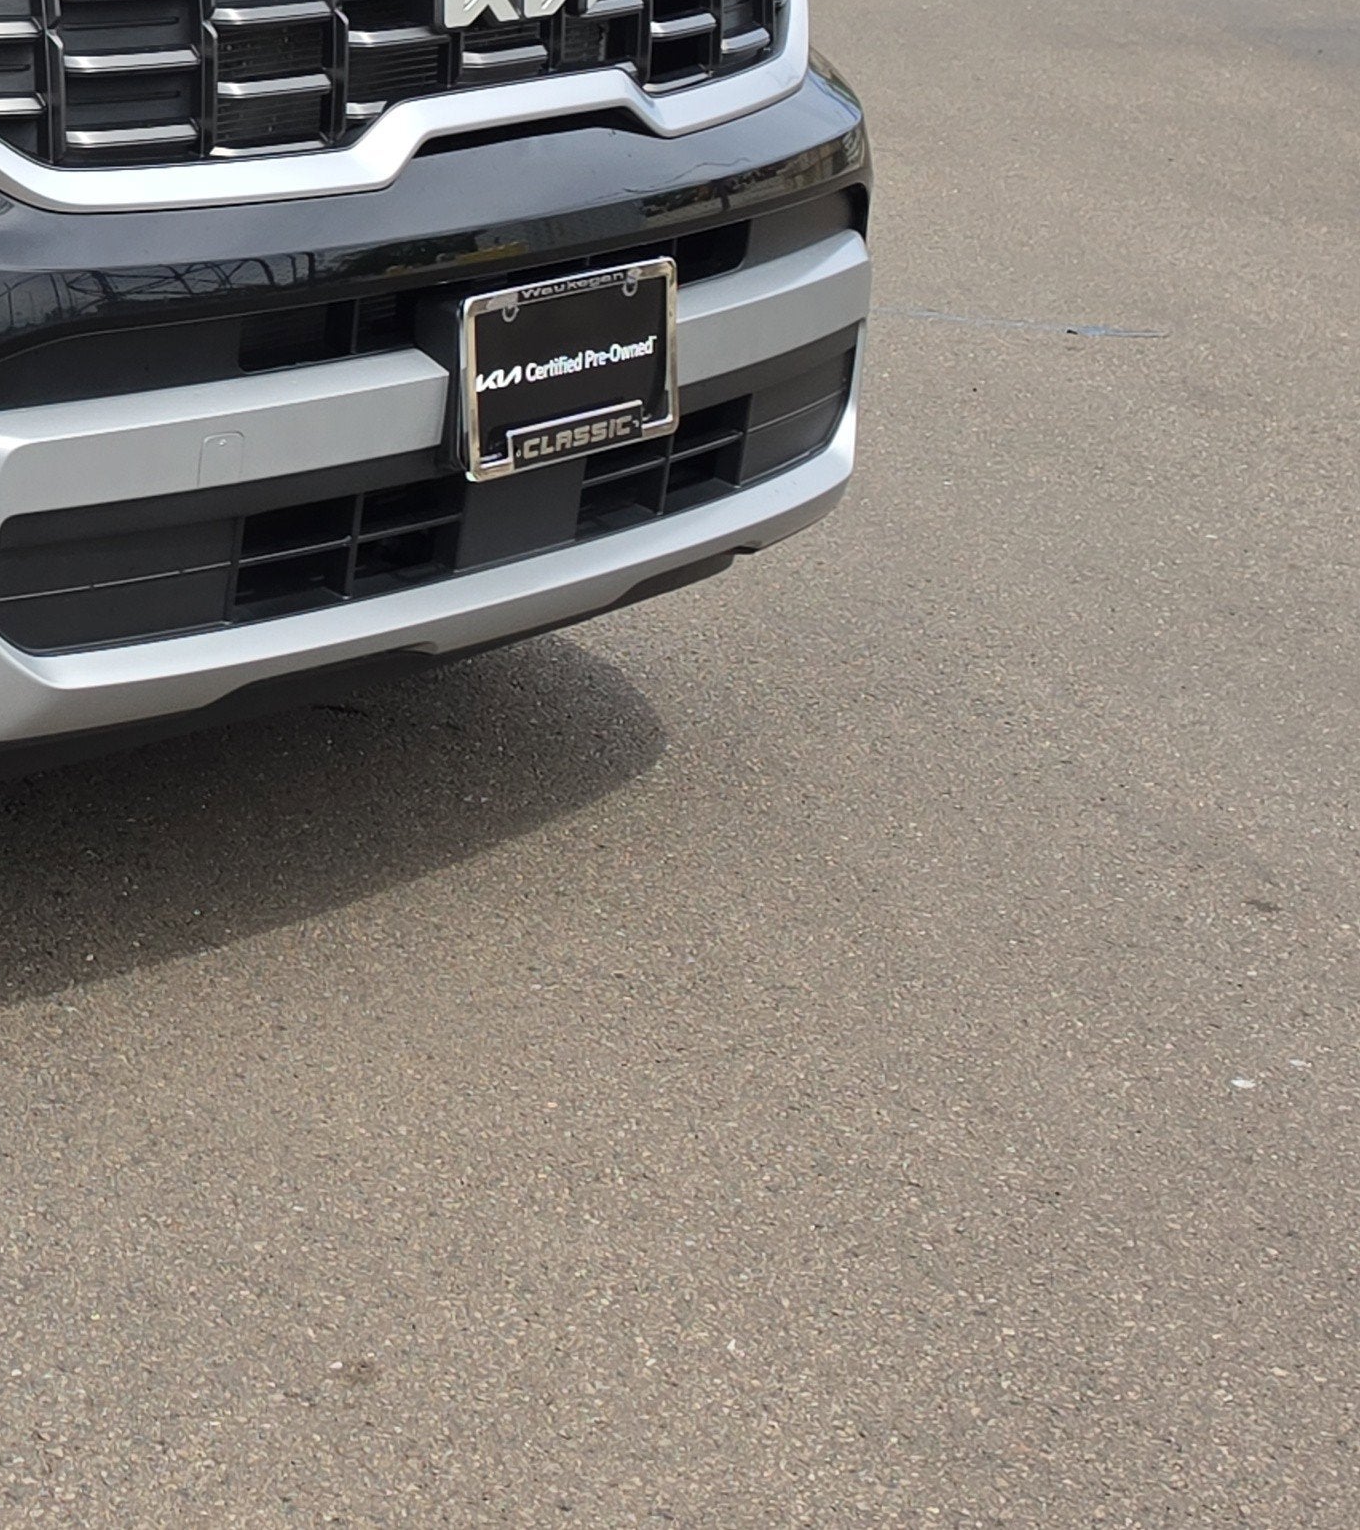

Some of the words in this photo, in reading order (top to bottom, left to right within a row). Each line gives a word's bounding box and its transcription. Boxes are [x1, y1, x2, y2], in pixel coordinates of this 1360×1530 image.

[520, 272, 624, 300] Waukegan
[475, 365, 522, 392] KIA
[525, 351, 583, 382] Certified
[584, 338, 654, 369] Pre-Owned
[522, 415, 633, 460] CLASSIC
